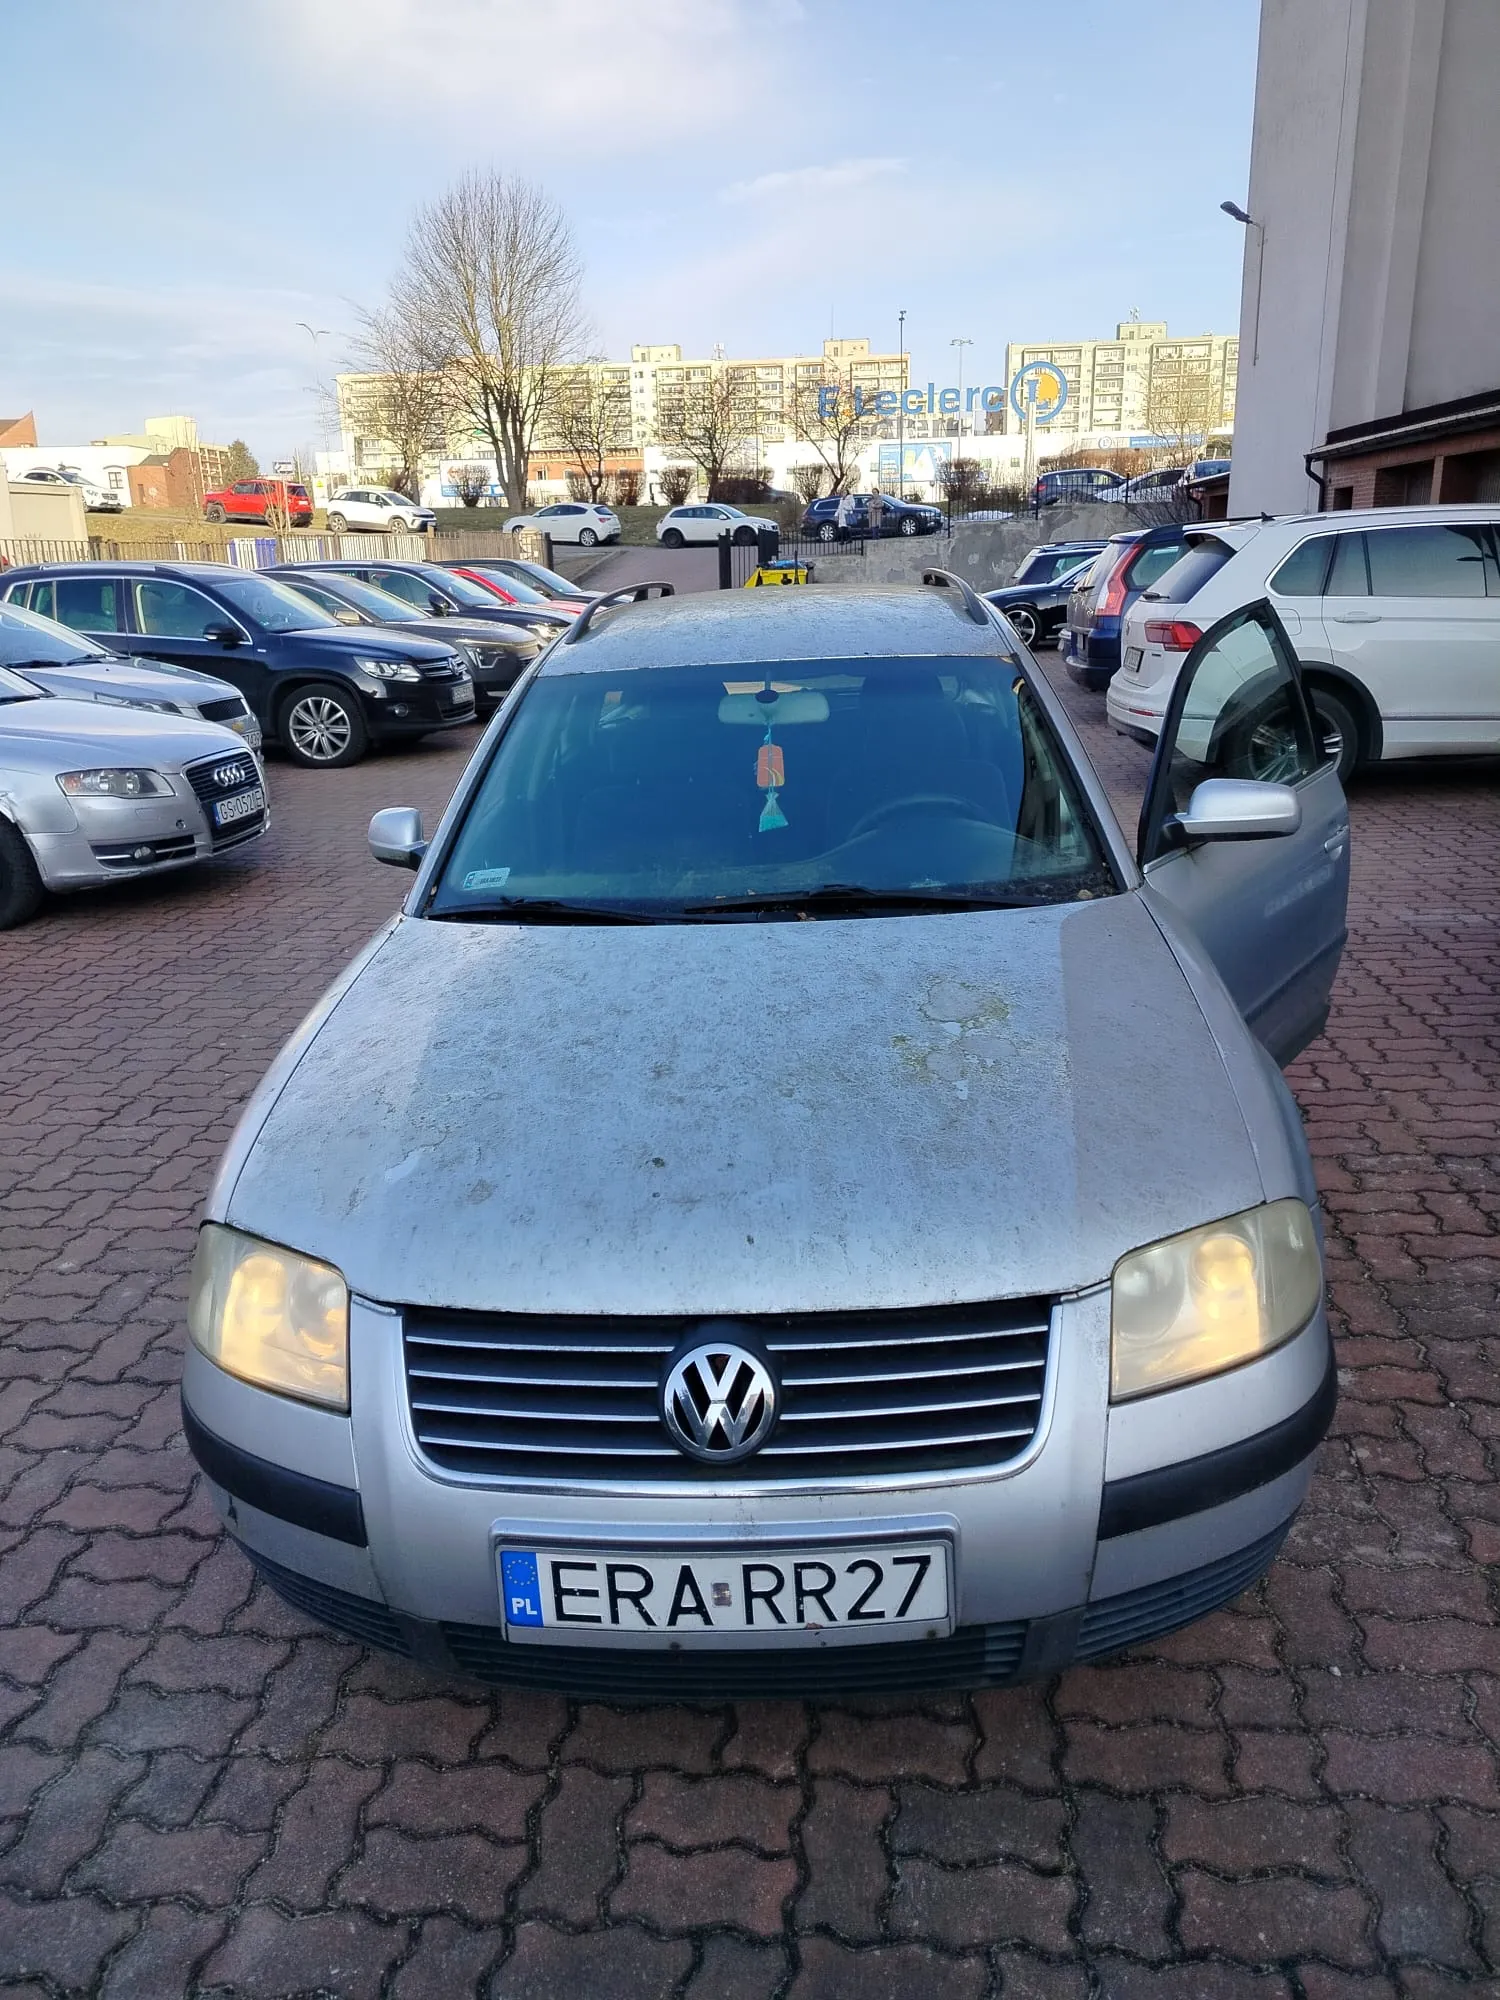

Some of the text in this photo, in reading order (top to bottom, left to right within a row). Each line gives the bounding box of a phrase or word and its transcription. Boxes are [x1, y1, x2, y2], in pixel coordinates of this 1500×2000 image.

[512, 1597, 538, 1615] PL
[550, 1555, 931, 1626] ERA RR27
